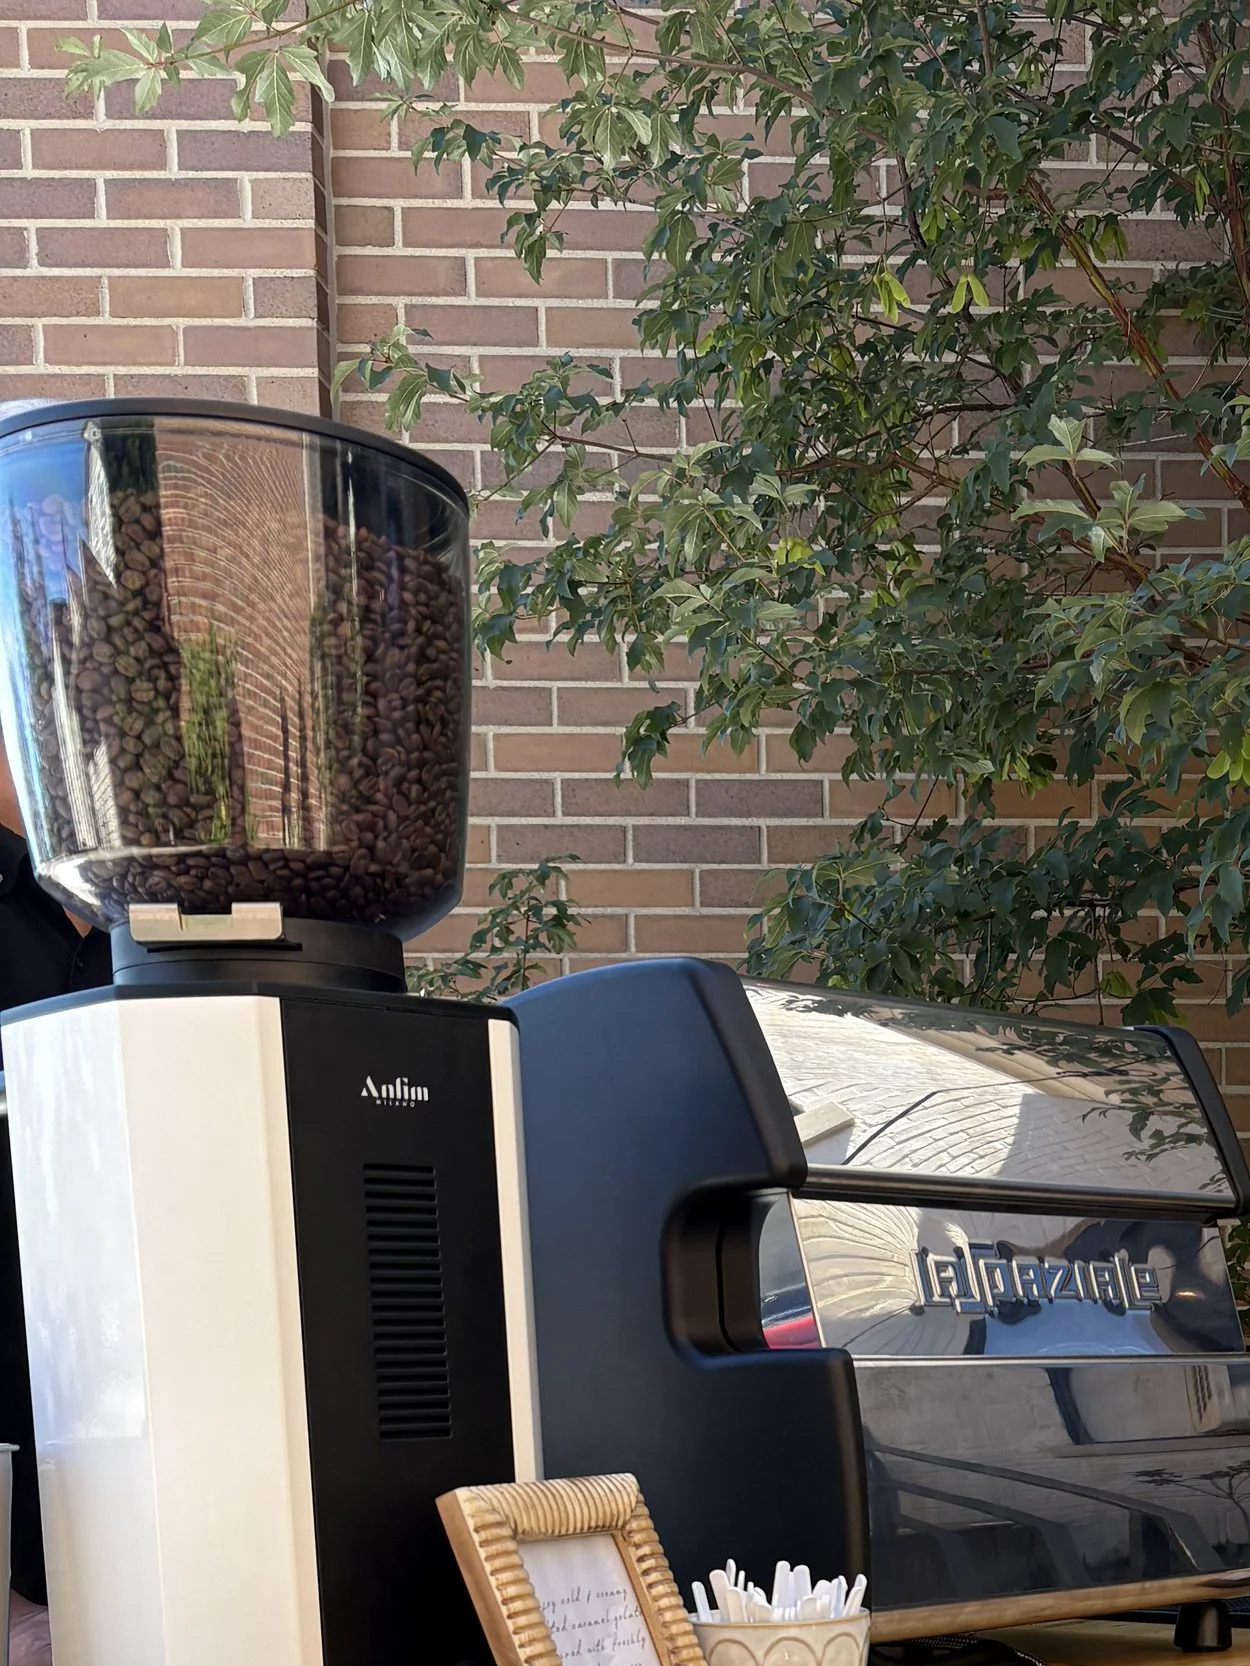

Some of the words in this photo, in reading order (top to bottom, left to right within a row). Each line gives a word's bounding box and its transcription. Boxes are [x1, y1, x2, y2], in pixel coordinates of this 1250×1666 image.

[361, 1075, 429, 1101] Anfim
[376, 1099, 415, 1108] MILANO
[541, 1600, 556, 1614] joy
[561, 1586, 581, 1605] cold
[596, 1588, 627, 1602] creamy
[549, 1615, 567, 1634] ted
[571, 1608, 610, 1630] caramel
[588, 1637, 606, 1653] with
[611, 1628, 646, 1652] freshly
